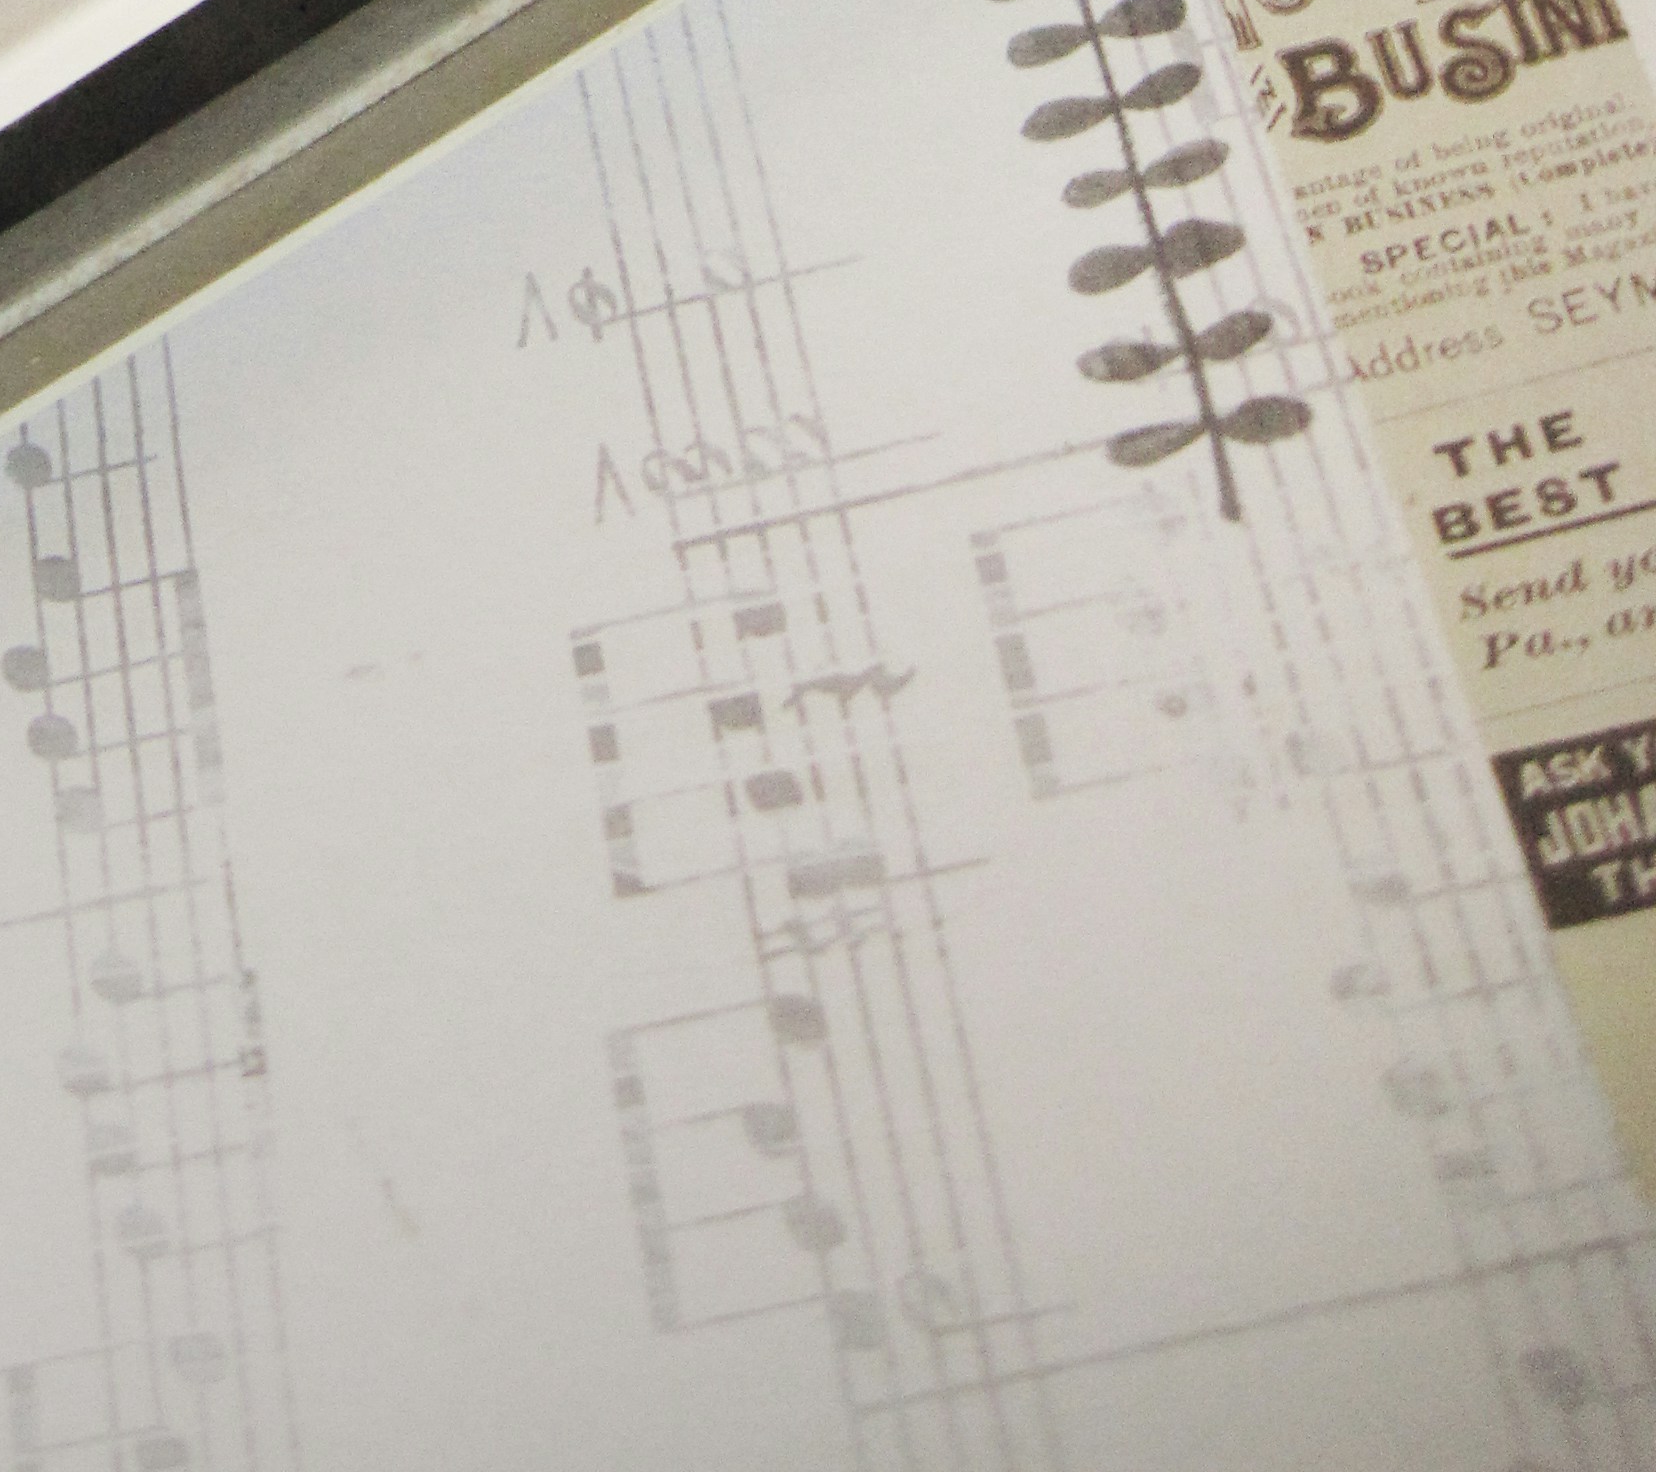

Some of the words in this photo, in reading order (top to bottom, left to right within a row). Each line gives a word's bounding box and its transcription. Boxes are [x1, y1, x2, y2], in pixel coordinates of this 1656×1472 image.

[1432, 409, 1585, 478] THE
[1432, 459, 1621, 544] BEST
[1459, 558, 1591, 623] Send
[1520, 743, 1613, 801] ASK
